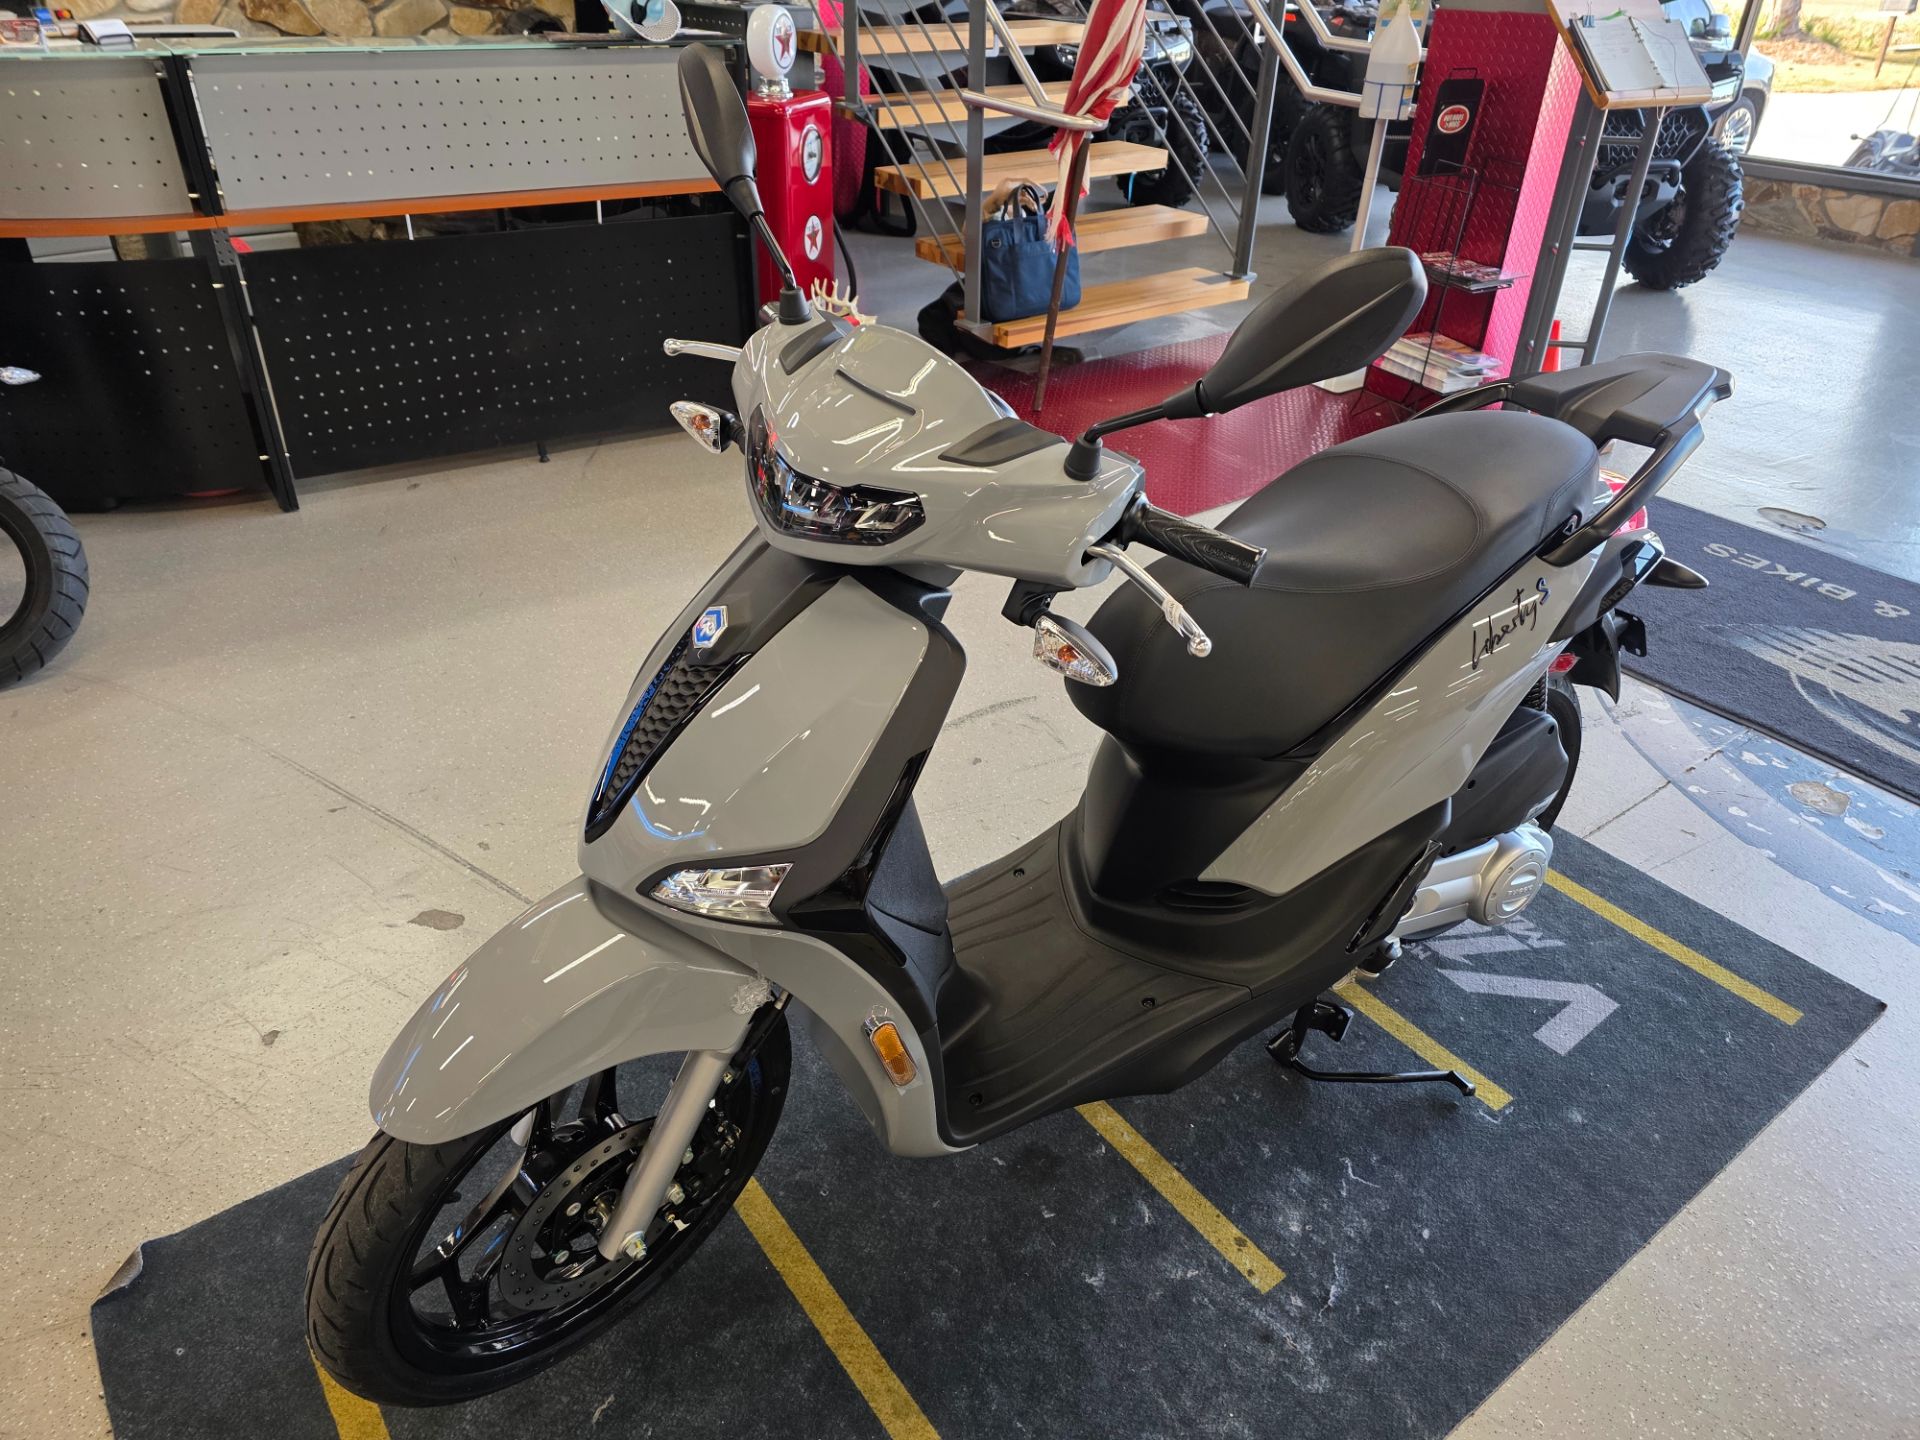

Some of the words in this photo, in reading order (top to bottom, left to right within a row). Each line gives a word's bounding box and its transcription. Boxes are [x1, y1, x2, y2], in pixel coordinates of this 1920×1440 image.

[1703, 543, 1857, 600] BIKES
[1472, 588, 1537, 670] Liberty
[1873, 600, 1912, 618] &
